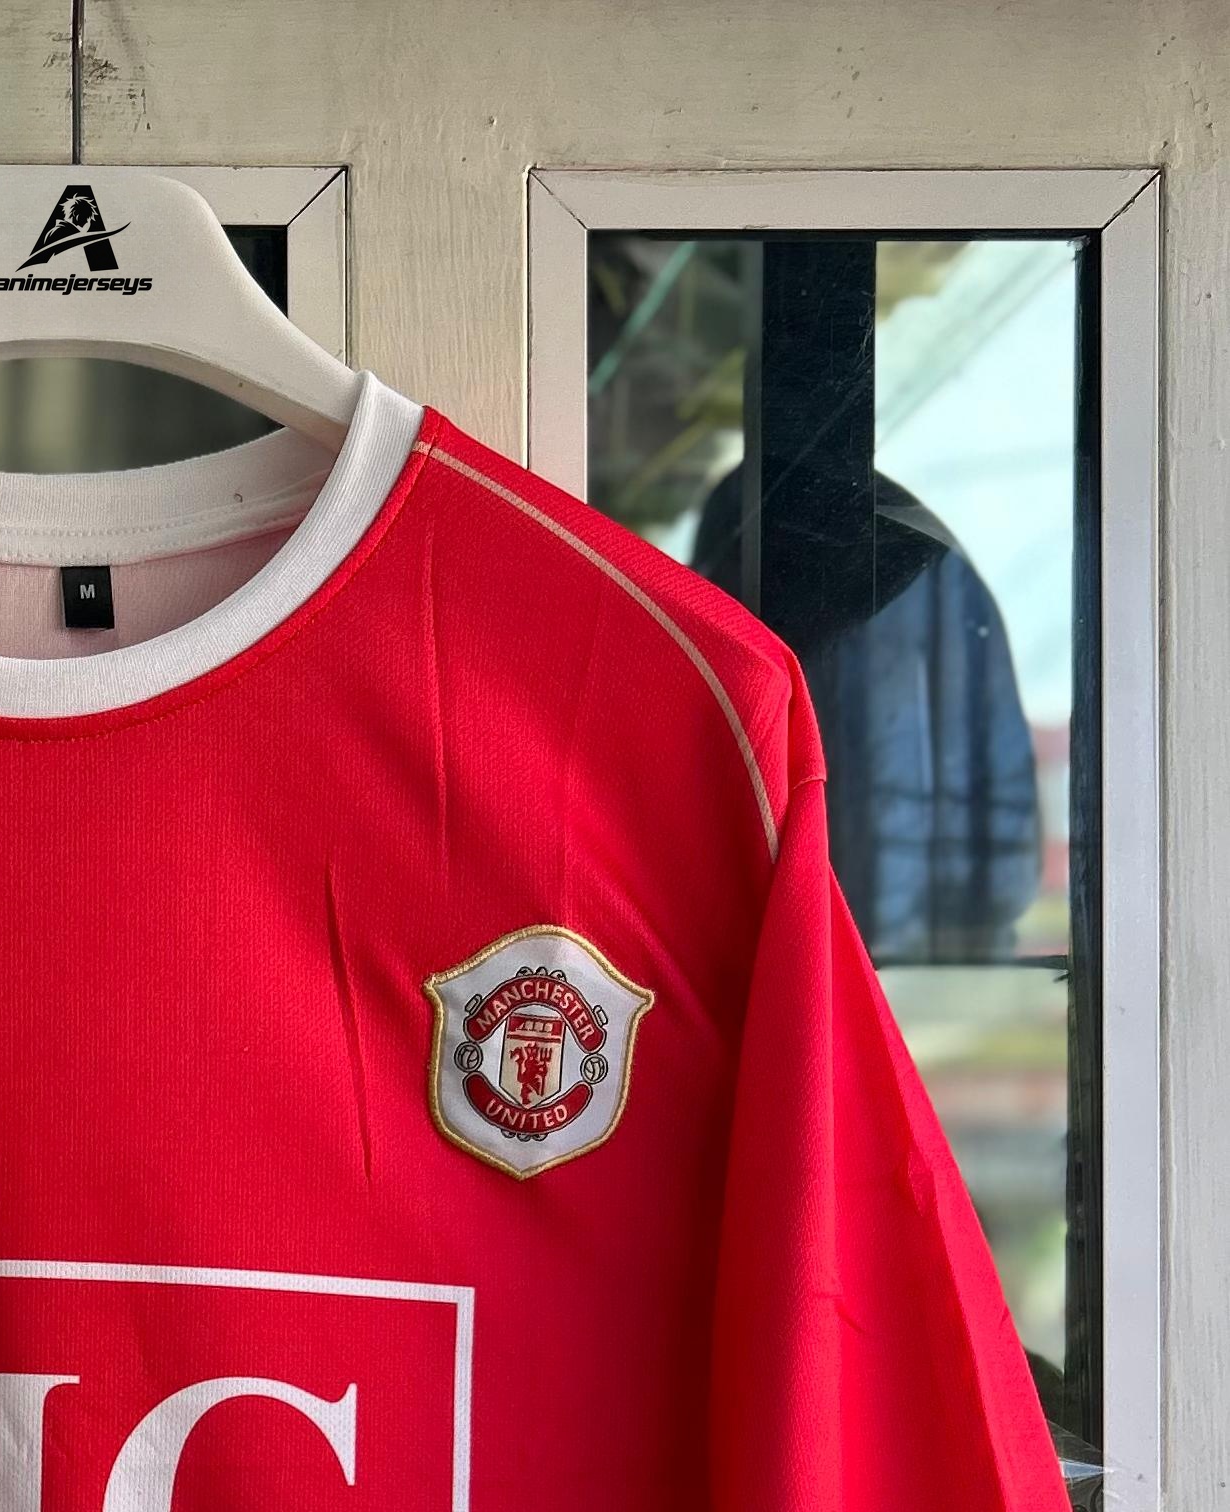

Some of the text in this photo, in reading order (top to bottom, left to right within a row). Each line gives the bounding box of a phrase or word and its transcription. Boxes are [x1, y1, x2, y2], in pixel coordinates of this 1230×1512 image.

[79, 584, 95, 599] M
[476, 981, 596, 1041] MANCHESTER
[484, 1099, 568, 1129] UNITED
